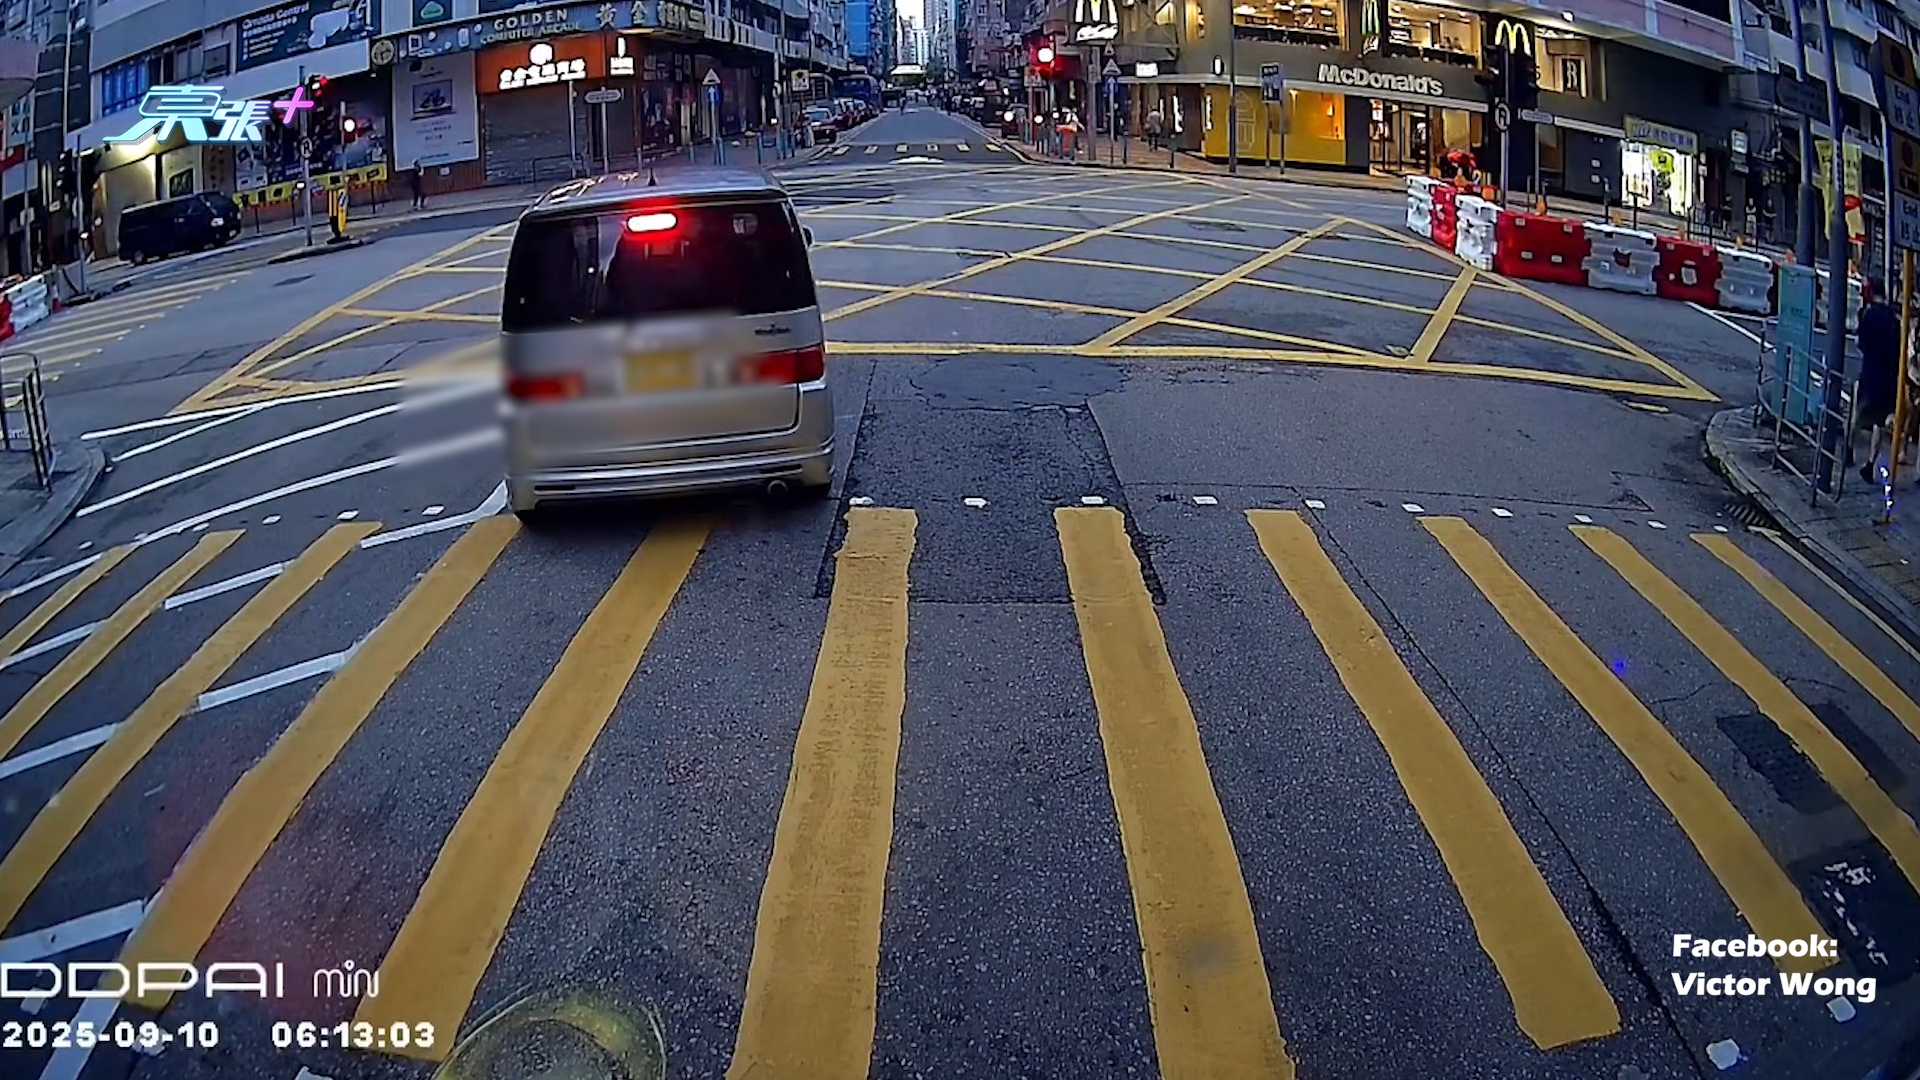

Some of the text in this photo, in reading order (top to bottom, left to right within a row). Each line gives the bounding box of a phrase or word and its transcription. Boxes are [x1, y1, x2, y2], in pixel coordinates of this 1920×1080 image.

[493, 8, 568, 31] GOLDEN
[538, 21, 582, 38] ARCADE
[1318, 63, 1444, 97] McDonald's
